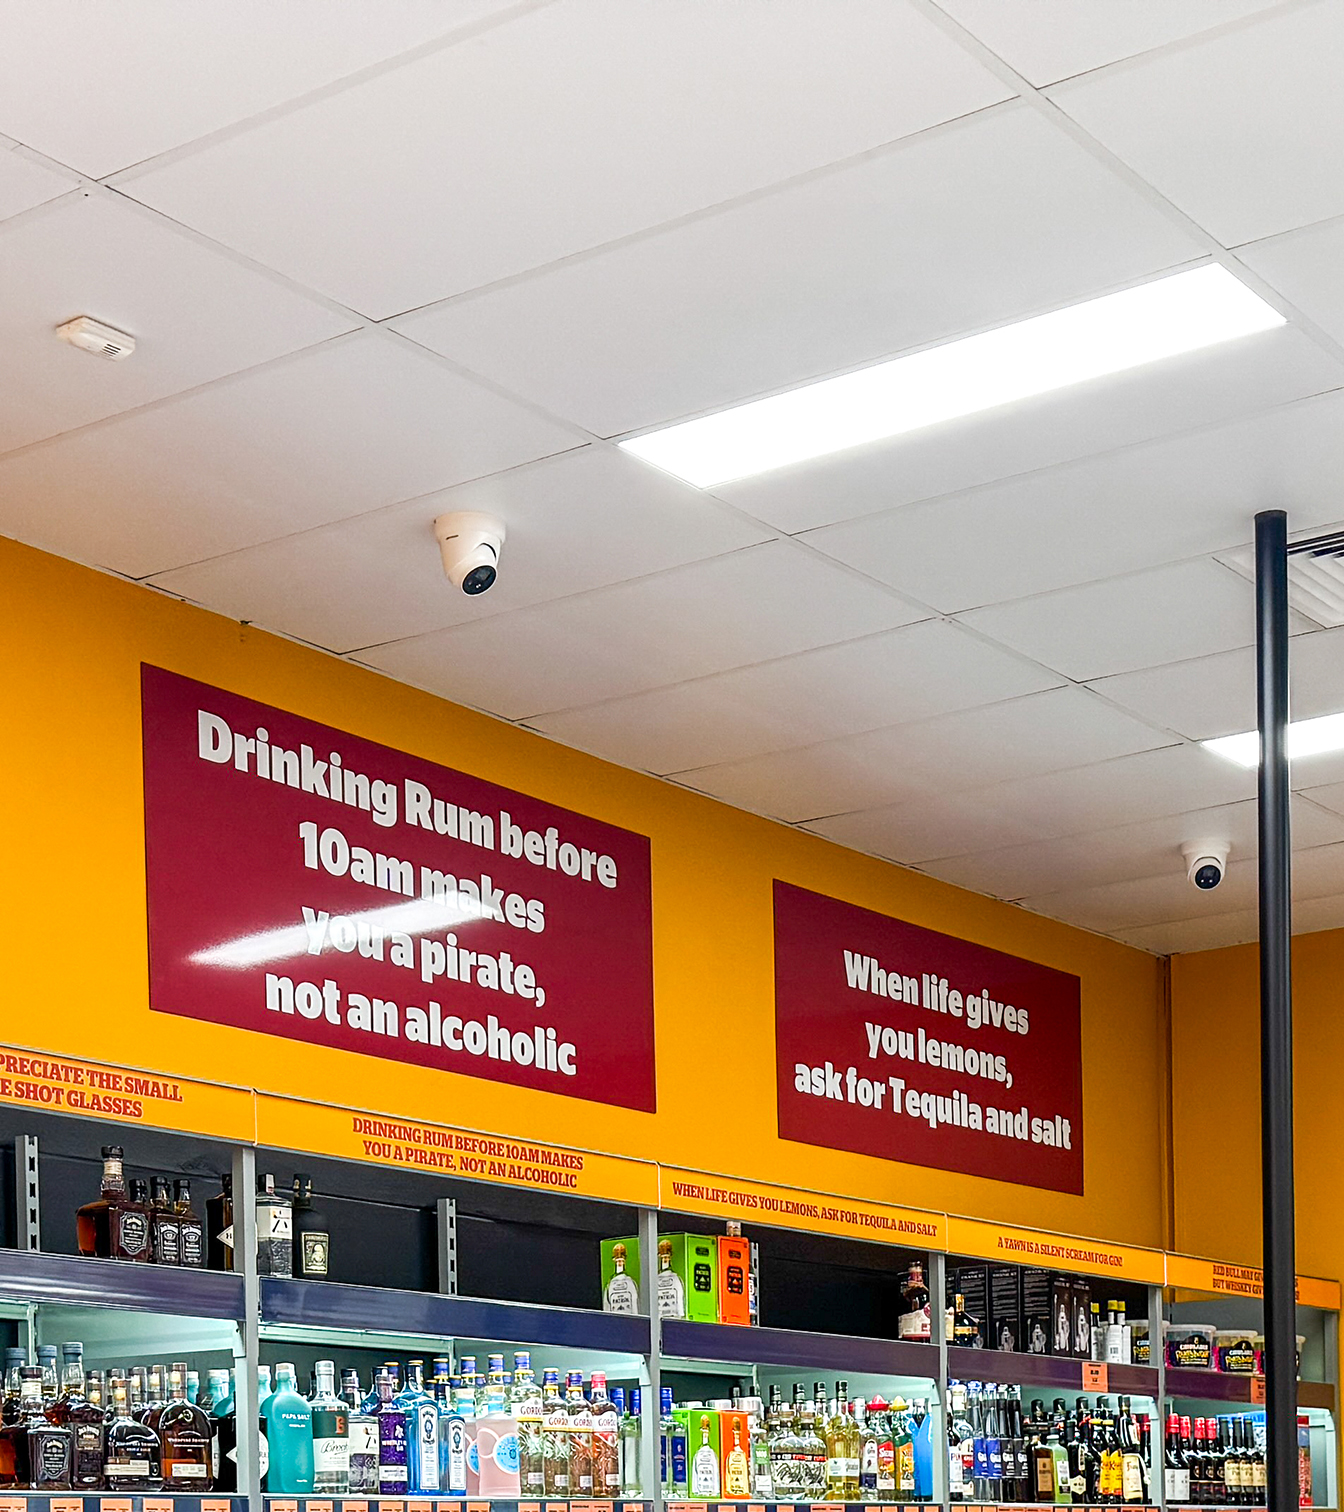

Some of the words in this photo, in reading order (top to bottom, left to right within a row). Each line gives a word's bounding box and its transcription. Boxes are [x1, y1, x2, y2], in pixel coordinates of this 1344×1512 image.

[197, 709, 397, 828] Drinking
[405, 779, 495, 850] Rum
[500, 811, 617, 888] before
[299, 821, 414, 896] 10am
[421, 866, 545, 933] makes
[301, 906, 386, 961] you
[391, 932, 414, 969] a
[421, 940, 546, 1008] pirate,
[265, 973, 341, 1025] not
[347, 994, 398, 1037] an
[405, 1001, 577, 1076] alcoholic
[844, 950, 918, 1006] When
[923, 973, 963, 1018] life
[967, 989, 1029, 1035] gives
[87, 1069, 122, 1091] THE
[125, 1078, 183, 1102] SMALL
[865, 1022, 914, 1059] you
[918, 1028, 1014, 1089] lemons,
[14, 1082, 63, 1104] SHOT
[67, 1090, 143, 1118] GLASSES
[794, 1062, 844, 1101] ask
[846, 1067, 886, 1109] for
[889, 1077, 983, 1130] Tequila
[986, 1106, 1028, 1142] and
[1031, 1115, 1072, 1150] salt
[353, 1117, 422, 1143] DRINKING
[423, 1130, 453, 1149] RUM
[455, 1135, 505, 1158] BEFORE
[506, 1144, 540, 1162] 10AM
[541, 1149, 583, 1170] MAKES
[364, 1140, 391, 1158] YOU
[393, 1146, 404, 1161] A
[406, 1148, 457, 1171] PIRATE,
[460, 1157, 487, 1174] NOT
[489, 1162, 506, 1176] AN
[508, 1165, 577, 1188] ALCOHOLIC
[673, 1182, 704, 1199] WHEN
[706, 1189, 727, 1203] LIFE
[729, 1192, 757, 1208] GIVES
[759, 1196, 778, 1211] YOU
[780, 1200, 820, 1219] LEMONS,
[821, 1207, 839, 1221] ASK
[840, 1211, 858, 1224] FOR
[859, 1213, 896, 1230] TEQUILA
[898, 1220, 917, 1233] AND
[917, 1224, 937, 1237] SALT
[998, 1237, 1003, 1248] A
[1005, 1238, 1026, 1251] YAWN
[1027, 1242, 1034, 1252] IS
[1035, 1243, 1040, 1254] A
[1041, 1244, 1065, 1258] SILENT
[1066, 1248, 1094, 1262] SCREAM
[1095, 1253, 1108, 1264] FOR
